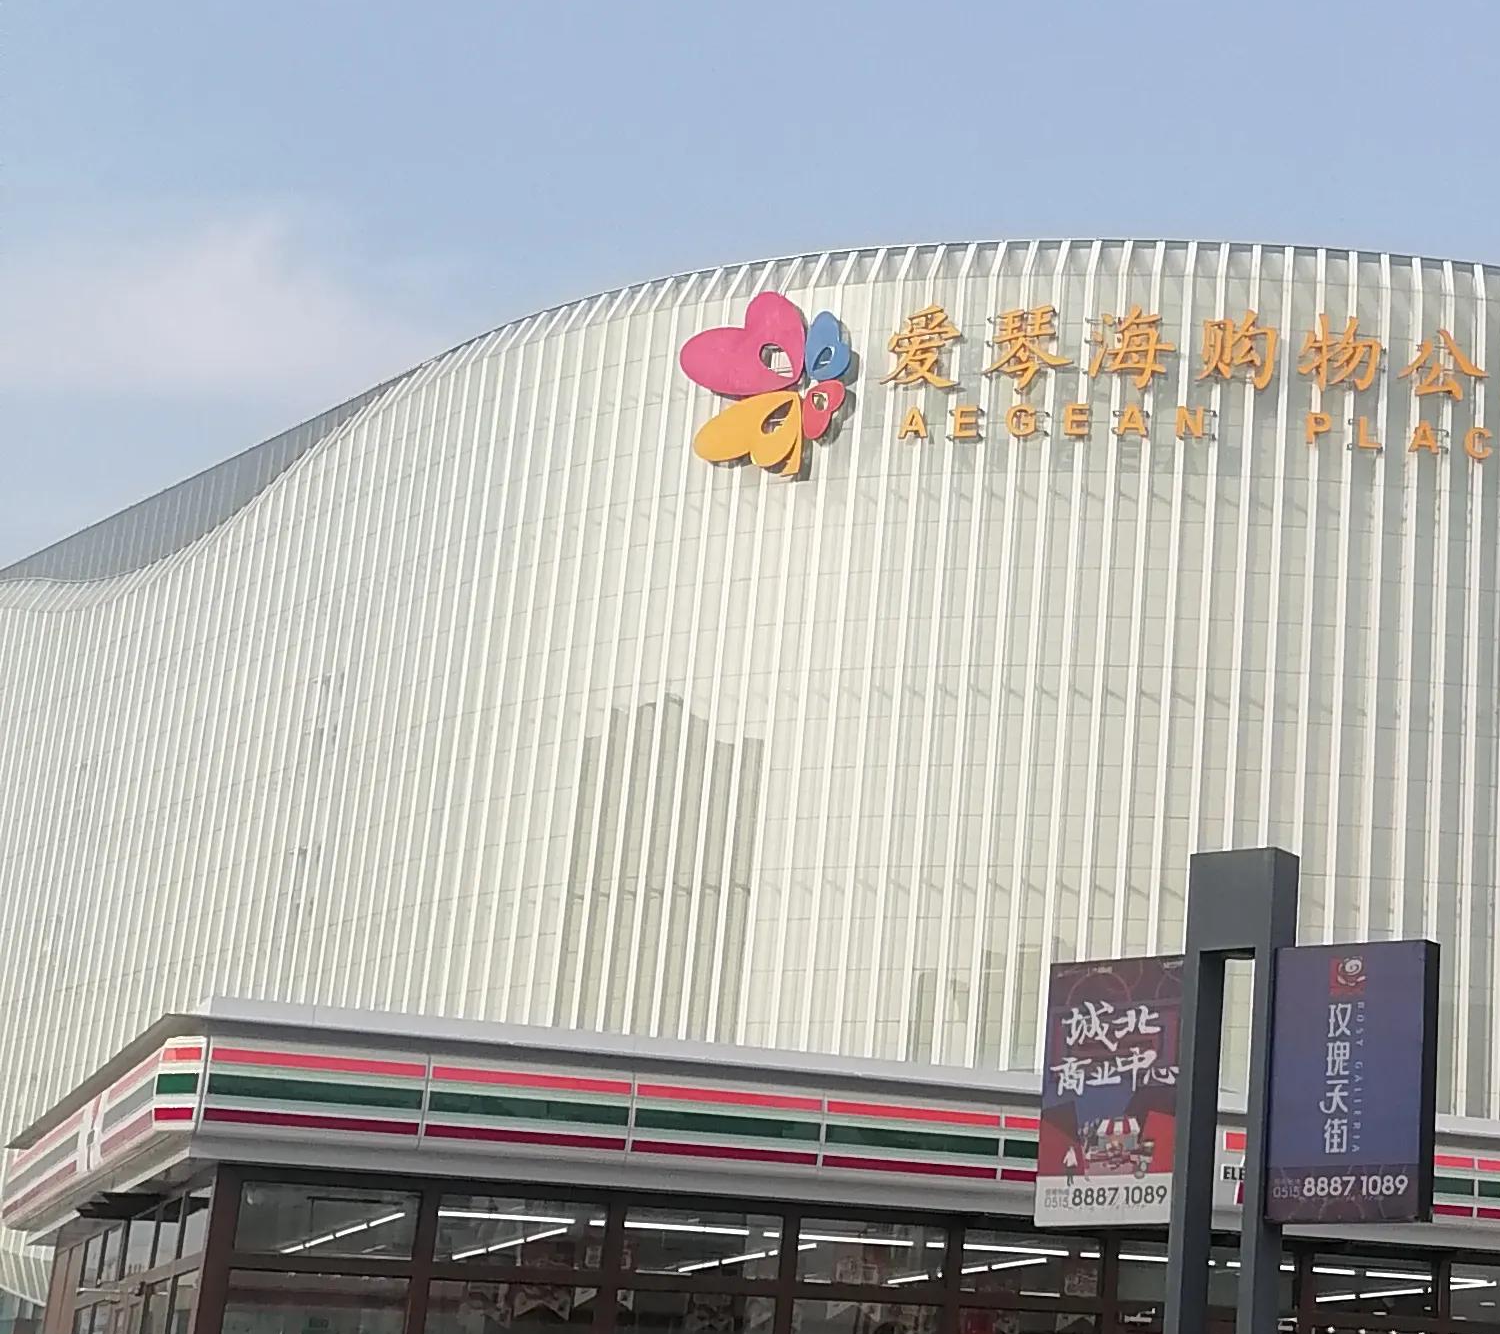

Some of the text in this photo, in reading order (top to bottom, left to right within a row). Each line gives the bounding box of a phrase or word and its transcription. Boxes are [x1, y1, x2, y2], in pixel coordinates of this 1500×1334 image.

[898, 405, 1208, 441] AEGEAN
[1061, 1000, 1163, 1052] 城北
[1050, 1047, 1180, 1097] 商业中心
[1319, 1002, 1353, 1156] 玫瑰天街
[1071, 1186, 1119, 1207] 8887
[1124, 1185, 1168, 1205] 1089
[1302, 1175, 1353, 1198] 8887
[1360, 1174, 1409, 1196] 1089
